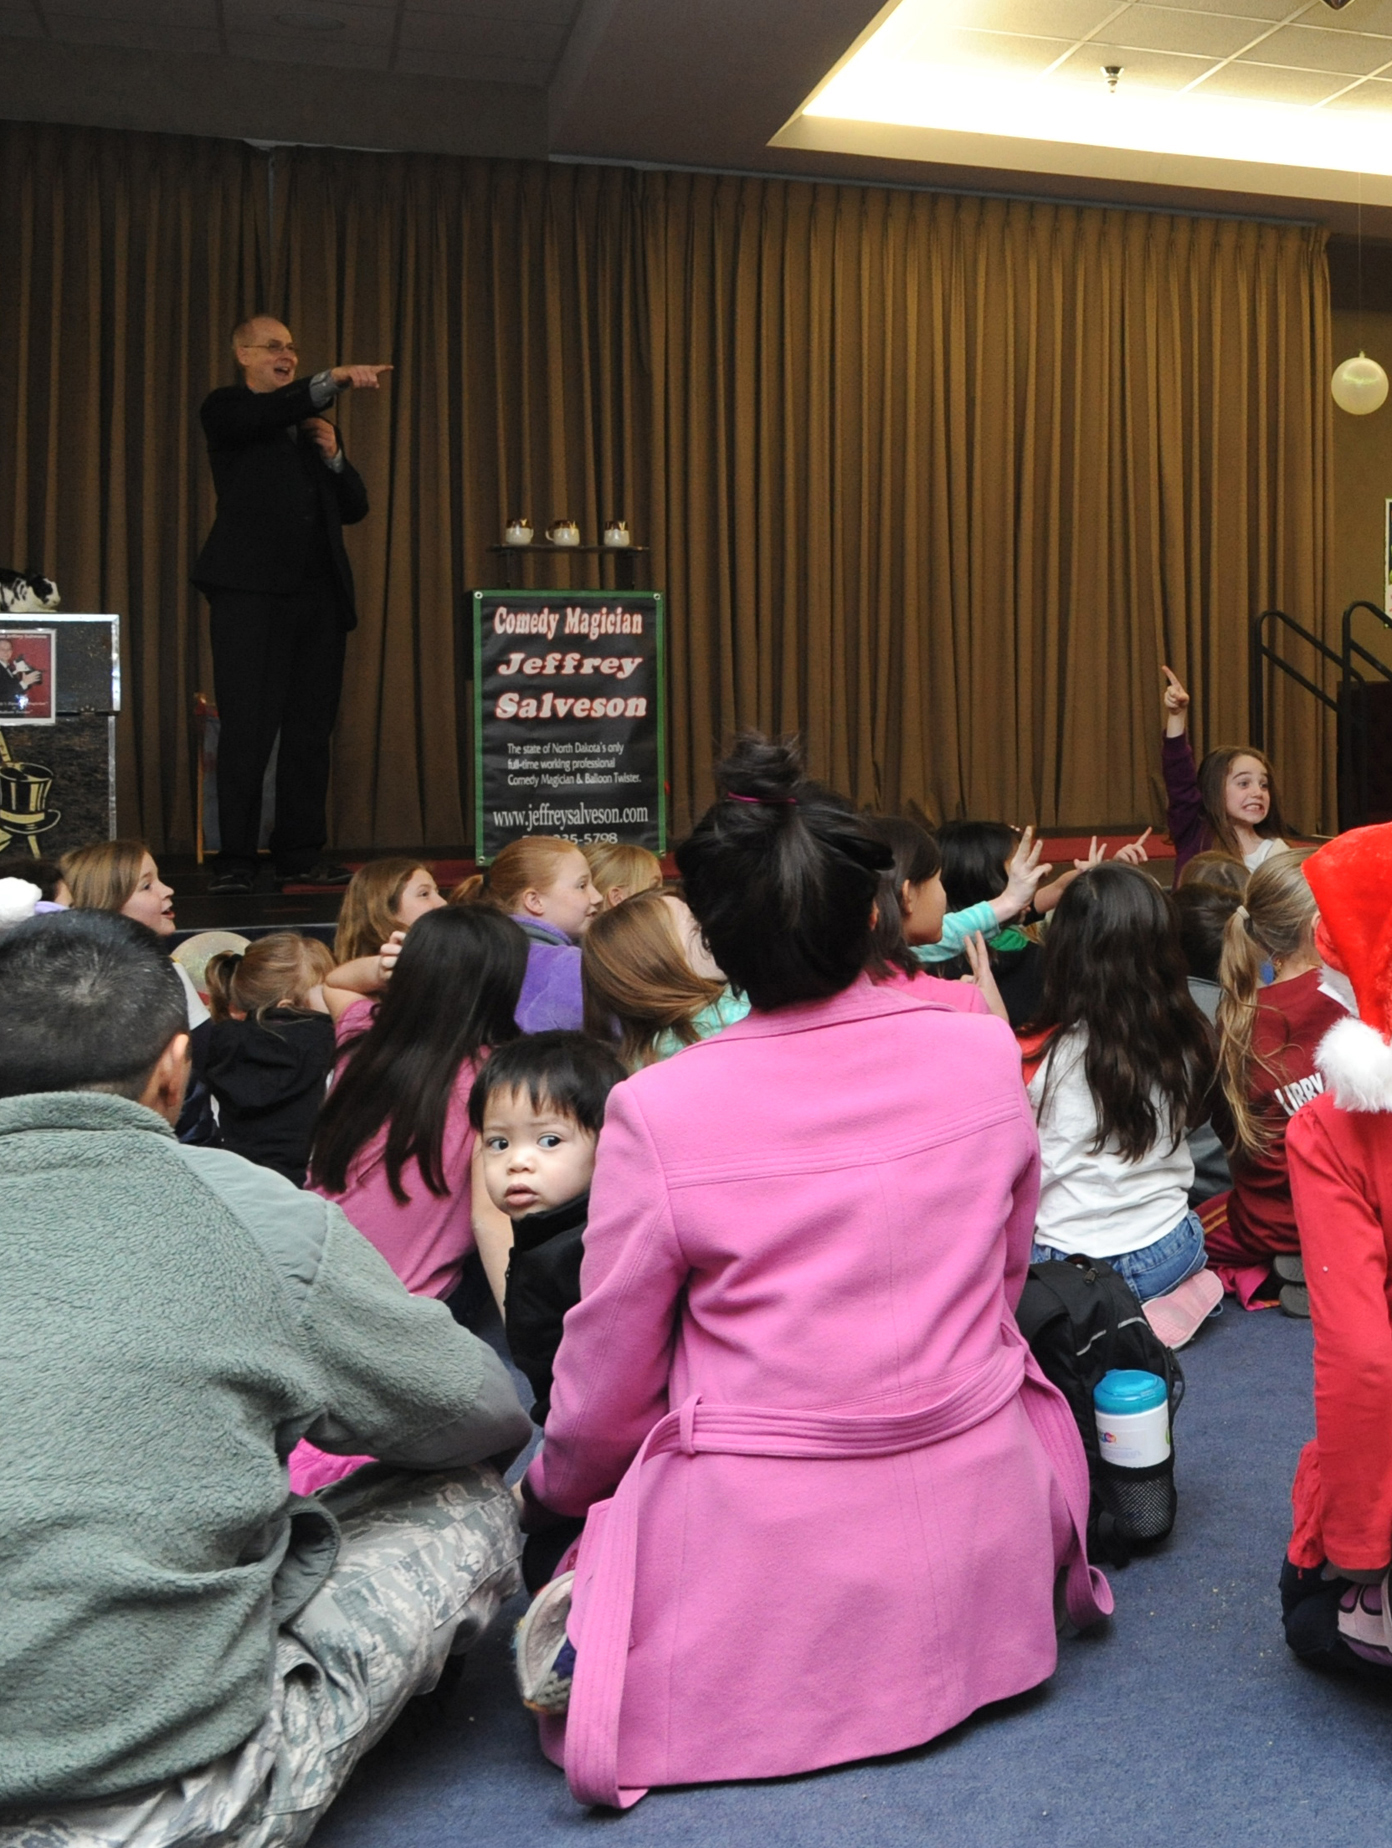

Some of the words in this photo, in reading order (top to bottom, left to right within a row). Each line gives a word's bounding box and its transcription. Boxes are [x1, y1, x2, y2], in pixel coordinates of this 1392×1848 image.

[494, 605, 560, 641] Comedy
[564, 605, 643, 641] Magician
[497, 651, 644, 680] Jeffrey
[495, 691, 648, 720] Salveson
[507, 743, 522, 754] The
[523, 743, 542, 754] state
[542, 742, 552, 754] of
[552, 742, 574, 754] North
[574, 741, 607, 753] Dakota's
[607, 741, 625, 755] only
[507, 758, 539, 770] full-time
[540, 758, 571, 772] working
[572, 757, 616, 771] professional
[507, 774, 540, 788] Comedy
[541, 773, 575, 788] Magician
[576, 772, 584, 784] &
[584, 772, 613, 784] Balloon
[492, 801, 649, 832] www.jeffreysalveson.com
